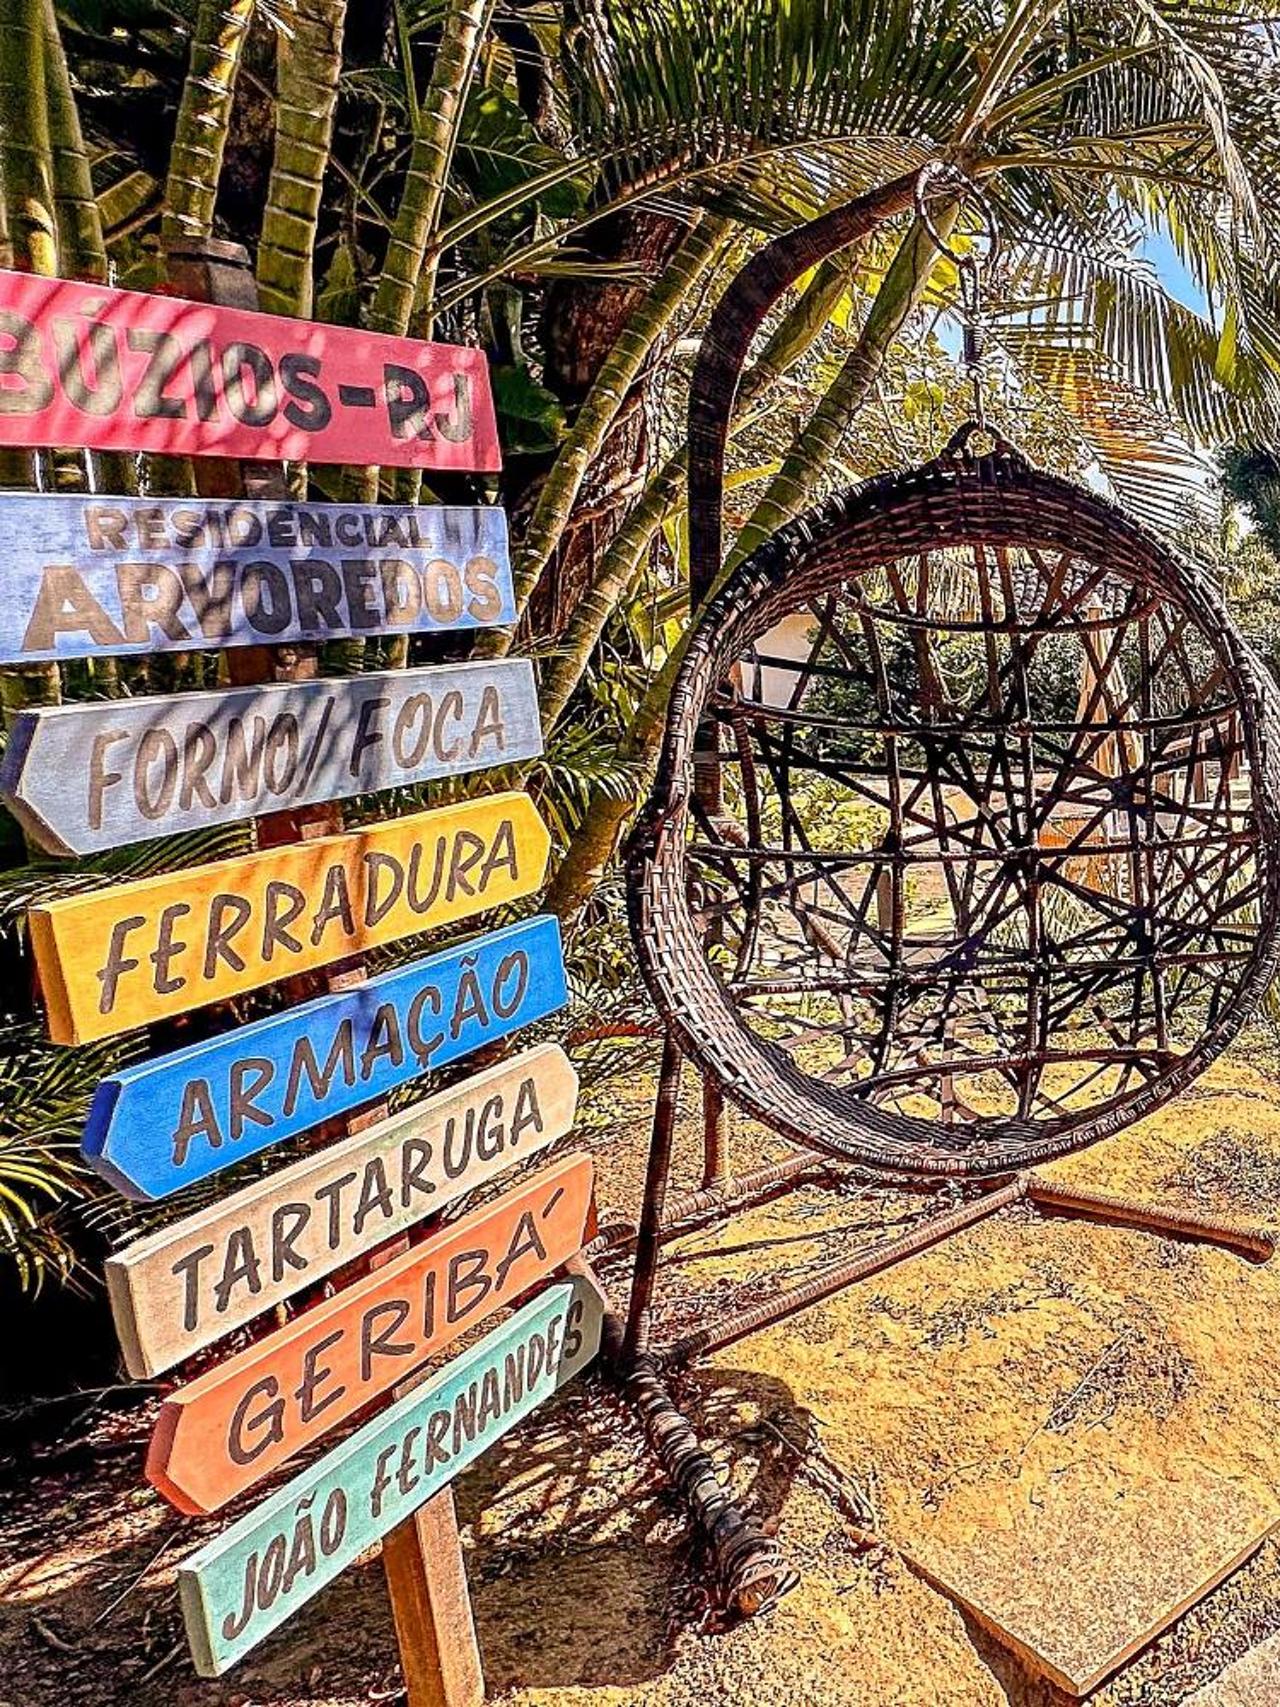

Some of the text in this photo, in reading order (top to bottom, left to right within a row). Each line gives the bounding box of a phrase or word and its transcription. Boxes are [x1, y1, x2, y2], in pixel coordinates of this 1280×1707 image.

[21, 556, 502, 652] ARVOREDOS
[97, 821, 518, 1014] FERRADURA
[172, 951, 528, 1166] ARMAÇÃO
[171, 1078, 544, 1332] TARTARUGA
[222, 1300, 583, 1641] JOÃO FERNANDES
